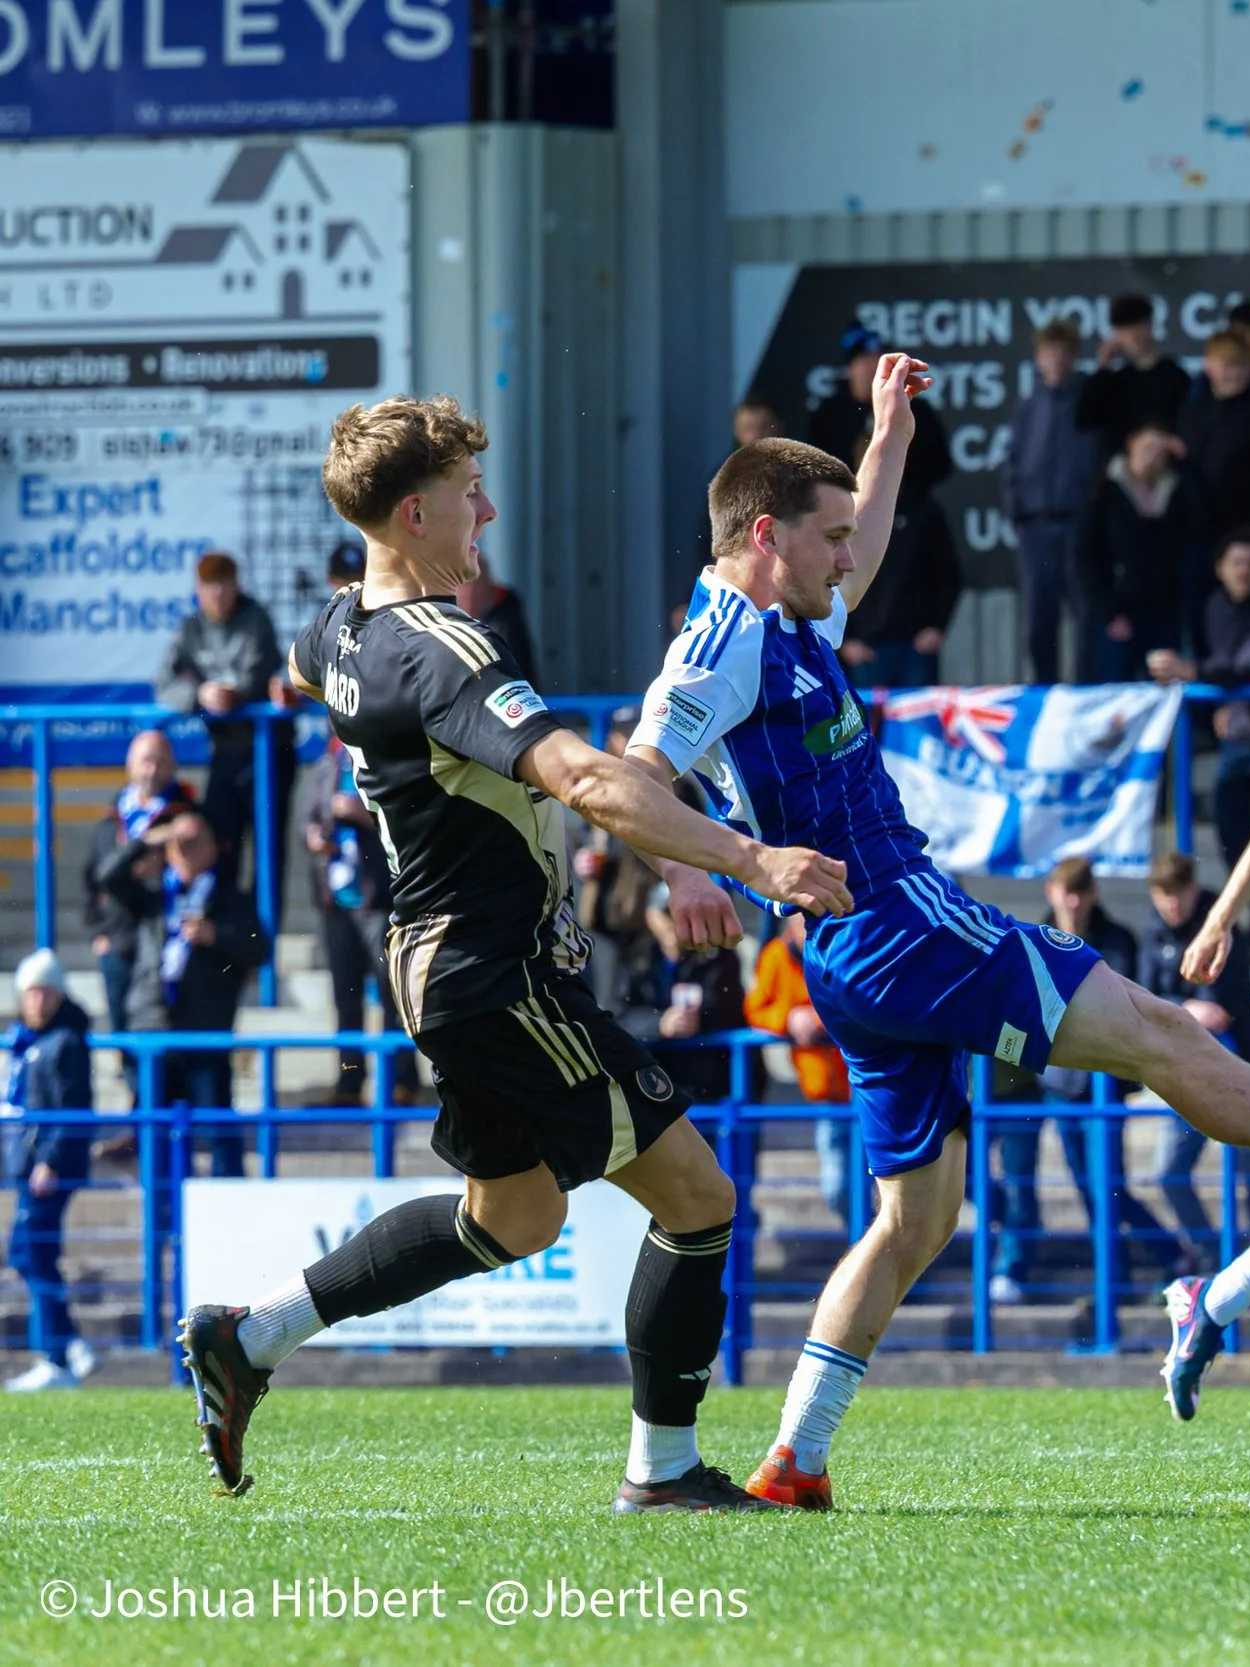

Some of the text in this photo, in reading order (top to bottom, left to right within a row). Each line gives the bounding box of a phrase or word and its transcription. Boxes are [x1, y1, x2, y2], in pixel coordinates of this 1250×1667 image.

[37, 276, 114, 312] LTD
[857, 301, 1011, 348] BEGIN
[806, 360, 1006, 412] SRTS
[21, 474, 163, 528] Expert
[0, 589, 199, 635] Manches
[325, 661, 360, 717] WARD
[667, 694, 705, 721] nterprise
